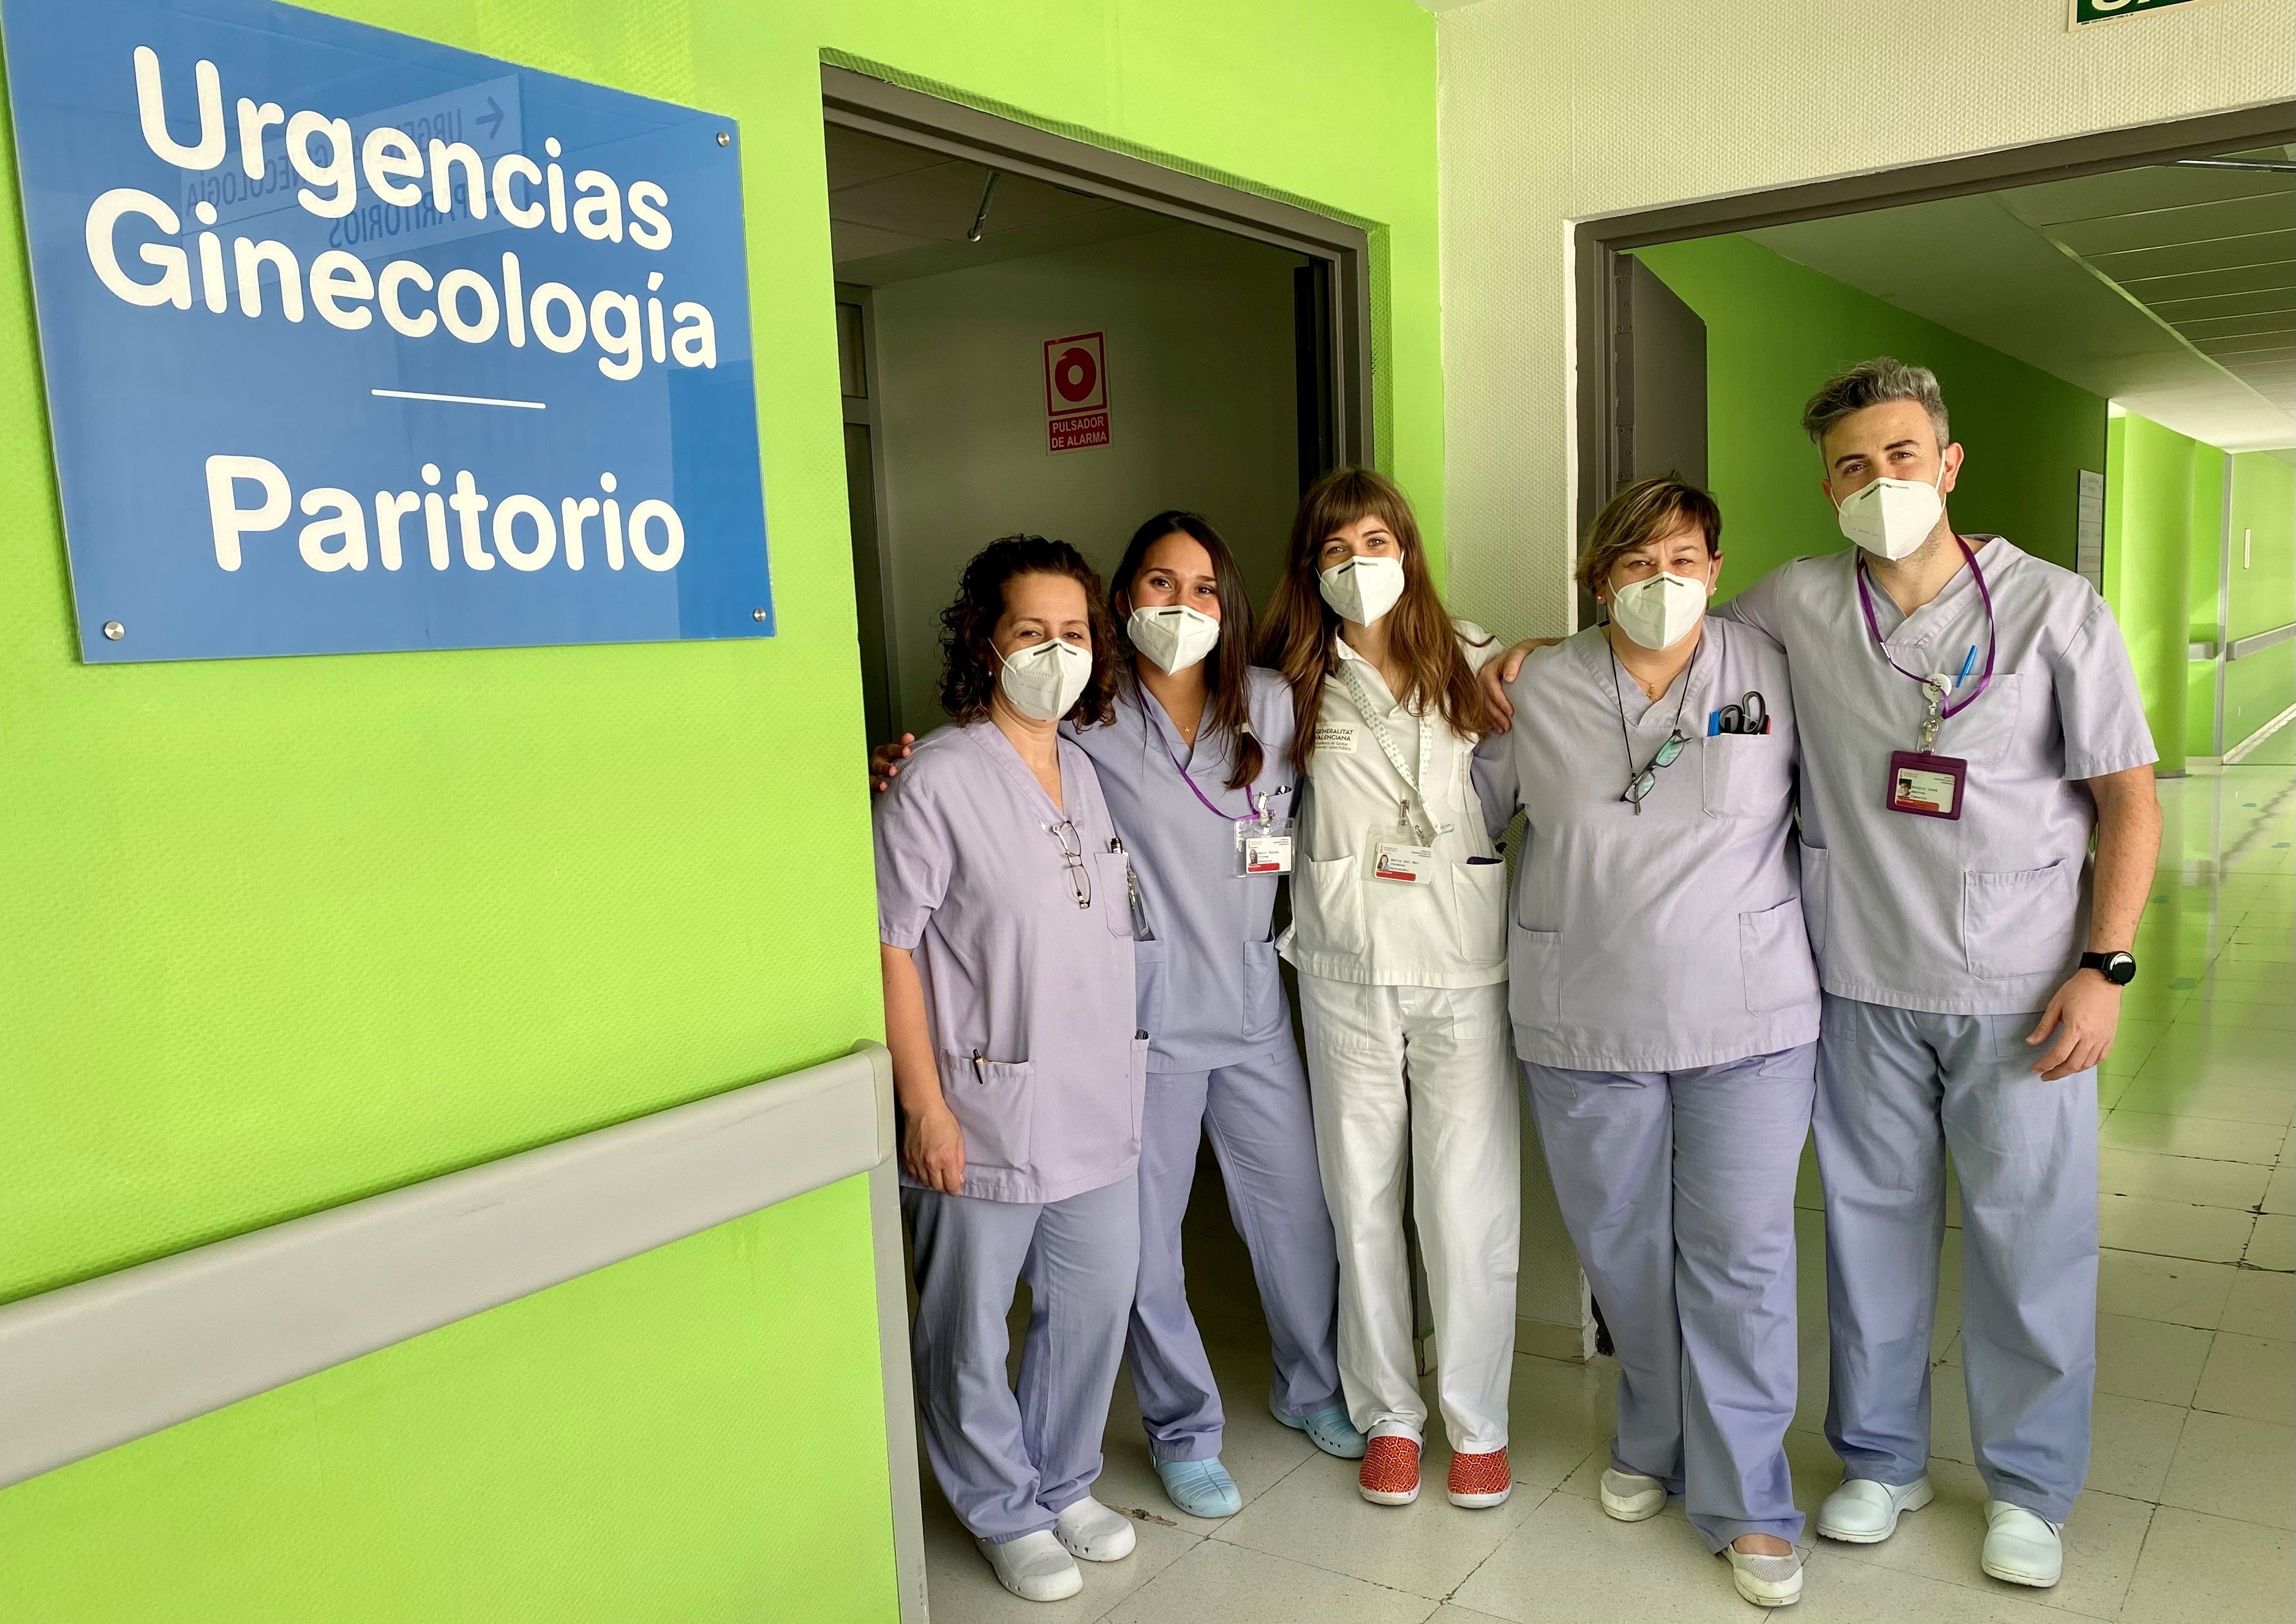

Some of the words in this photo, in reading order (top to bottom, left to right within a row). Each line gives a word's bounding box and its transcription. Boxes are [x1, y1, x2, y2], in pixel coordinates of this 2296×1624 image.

[133, 45, 673, 251] Urgencias
[85, 187, 717, 381] Ginecología
[1052, 416, 1104, 434] PULSADOR
[1052, 437, 1064, 448] DE
[1067, 431, 1107, 446] ALARMA
[205, 454, 685, 573] Paritorio
